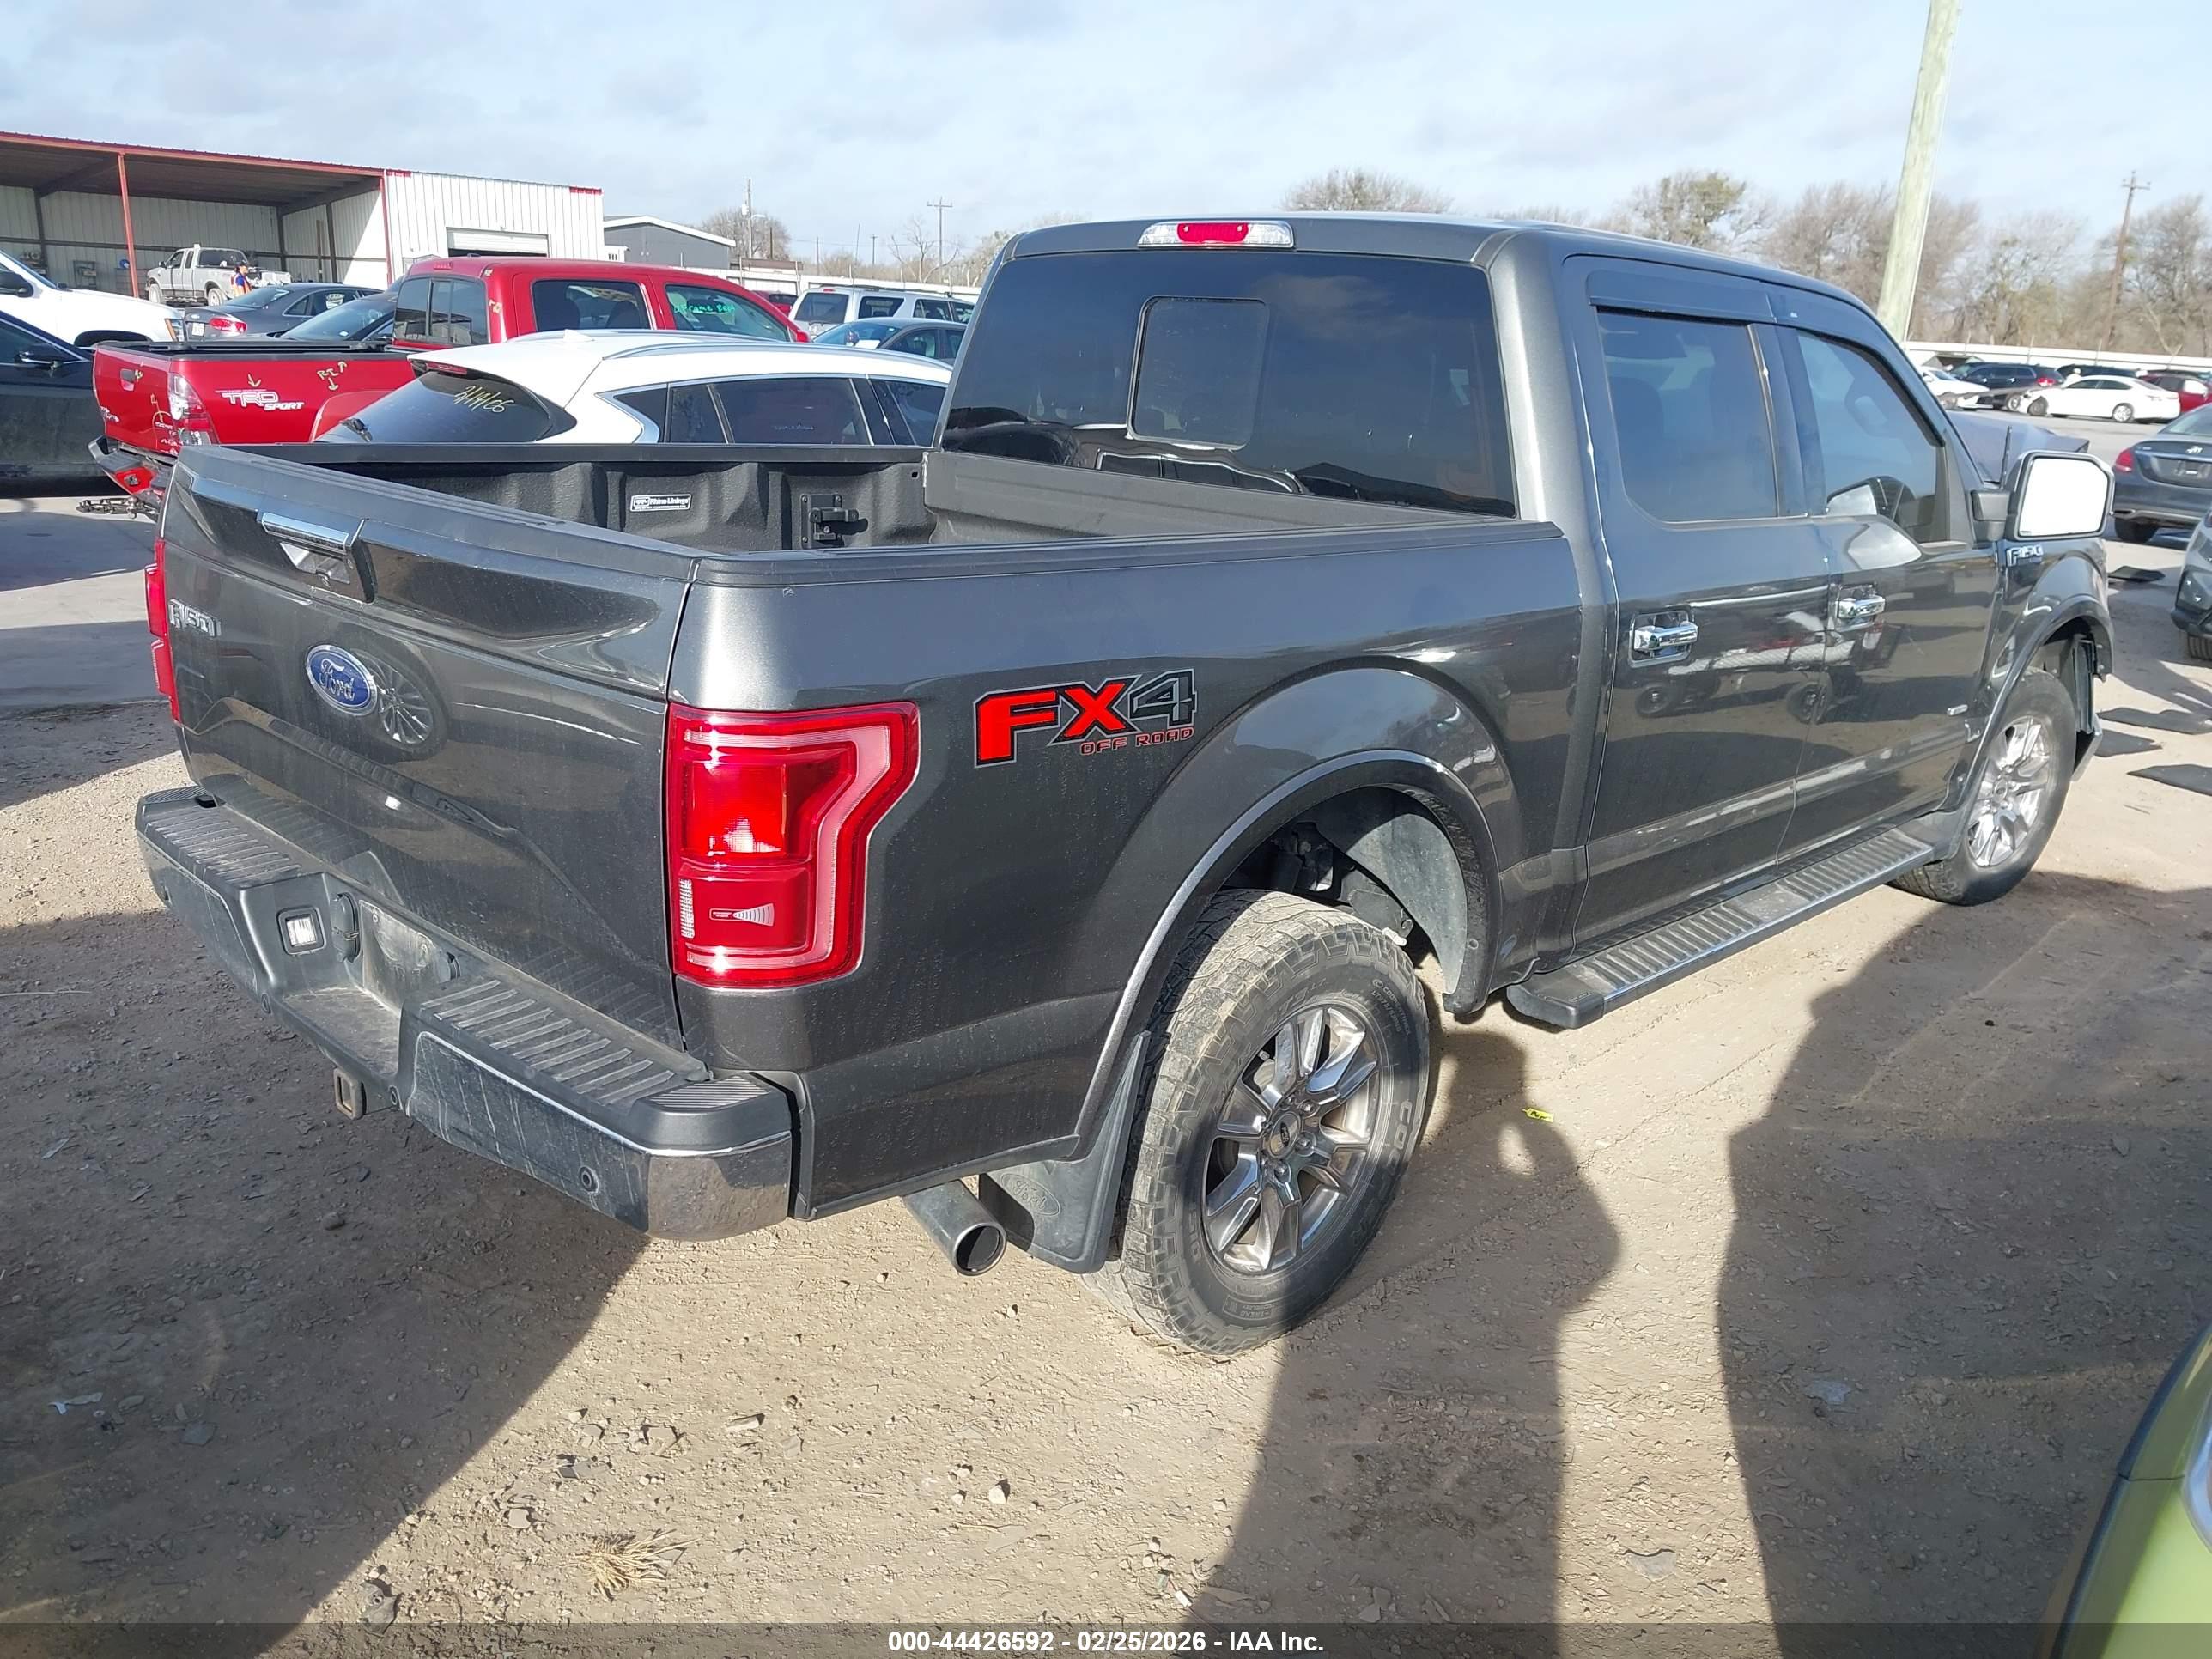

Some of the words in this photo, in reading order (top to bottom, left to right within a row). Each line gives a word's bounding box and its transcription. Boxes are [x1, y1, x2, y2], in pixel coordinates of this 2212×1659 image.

[222, 391, 279, 407] TRD
[264, 402, 305, 410] SPORT
[318, 658, 356, 702] Ford
[973, 668, 1197, 769] FX4
[1080, 737, 1127, 756] OFF
[1135, 727, 1194, 748] ROAD
